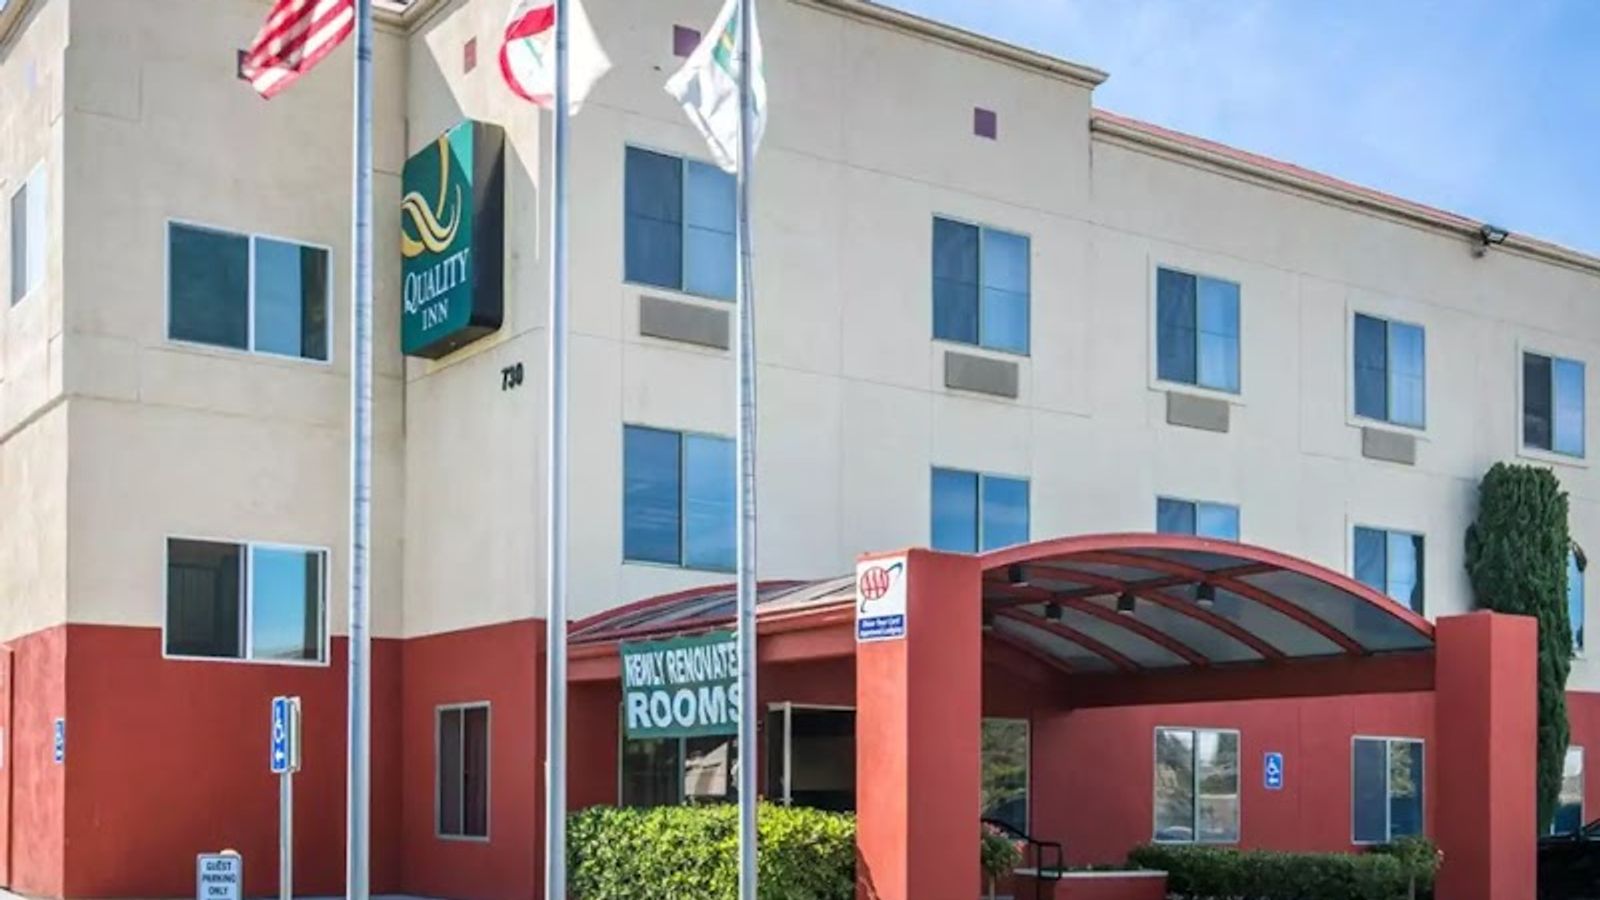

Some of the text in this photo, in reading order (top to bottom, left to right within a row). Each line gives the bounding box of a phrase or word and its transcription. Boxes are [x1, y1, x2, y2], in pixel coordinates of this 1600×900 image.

[405, 248, 469, 313] QUALITY
[421, 297, 449, 331] INN
[501, 363, 524, 390] 730
[624, 642, 739, 686] NEWLY RENOVATE
[202, 874, 236, 883] PARKING
[206, 860, 231, 871] GUEST
[208, 886, 228, 895] ONLY
